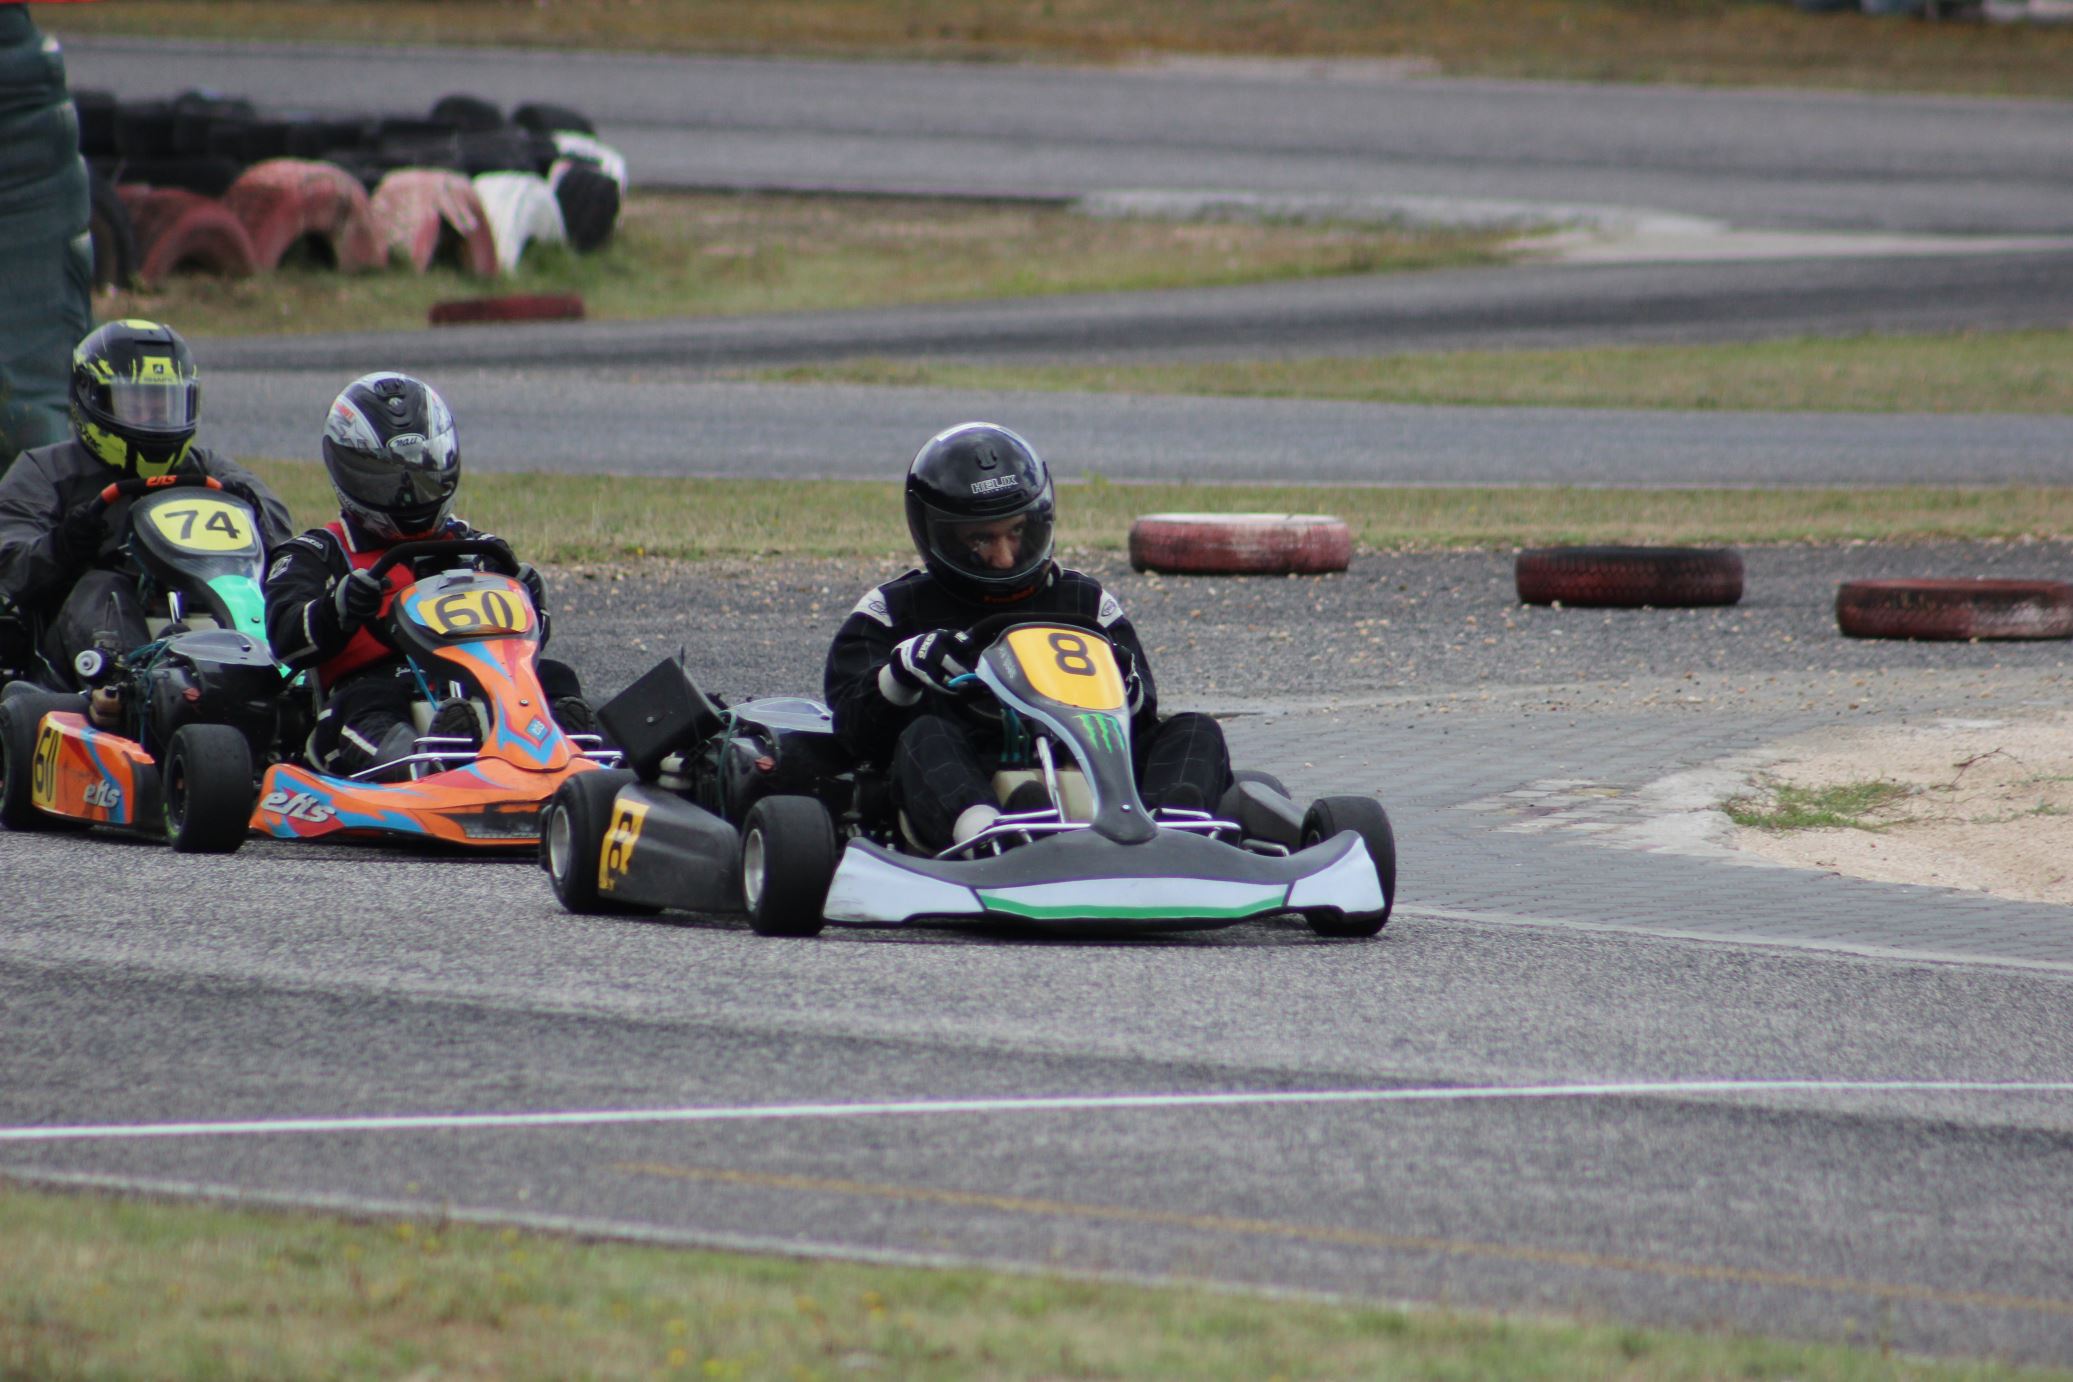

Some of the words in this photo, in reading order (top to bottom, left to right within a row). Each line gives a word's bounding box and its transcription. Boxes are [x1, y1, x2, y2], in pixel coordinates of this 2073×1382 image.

[970, 474, 1019, 494] HELIX
[164, 509, 241, 540] 74
[434, 591, 514, 630] 60
[1048, 632, 1097, 677] 8
[35, 726, 60, 803] 60
